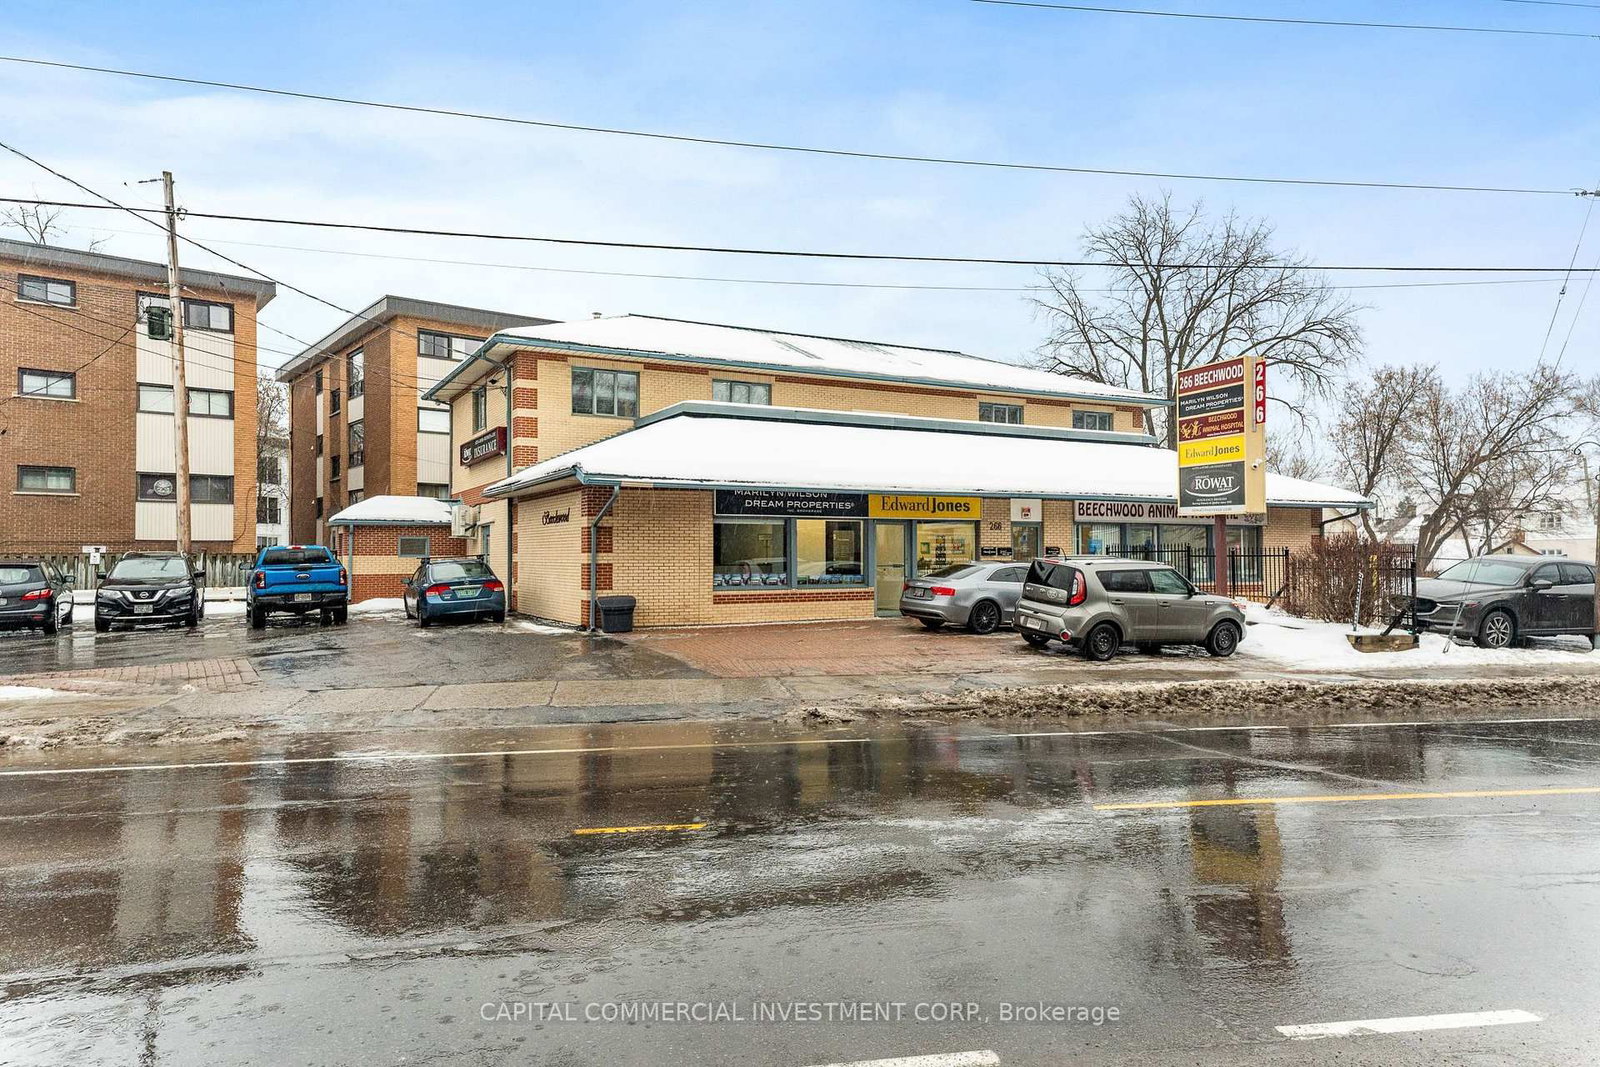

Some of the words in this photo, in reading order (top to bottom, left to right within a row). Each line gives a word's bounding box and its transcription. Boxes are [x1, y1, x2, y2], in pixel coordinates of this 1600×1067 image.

[1179, 376, 1193, 390] 266
[1194, 364, 1244, 386] BEECHWOOD
[1180, 398, 1205, 406] MARILYN
[1206, 392, 1229, 401] WILSON
[1185, 404, 1205, 412] DREAM
[1206, 397, 1241, 407] PROPERTIES
[1208, 413, 1238, 423] BEECHWOOD
[1202, 425, 1221, 433] ANIMAL
[1220, 421, 1244, 431] HOSPITAL
[1194, 476, 1235, 490] ROWAT
[745, 499, 784, 508] DREAM
[786, 500, 852, 510] PROPERTIES
[1078, 502, 1144, 518] BEECHWOOD
[1148, 503, 1188, 519] ANIM
